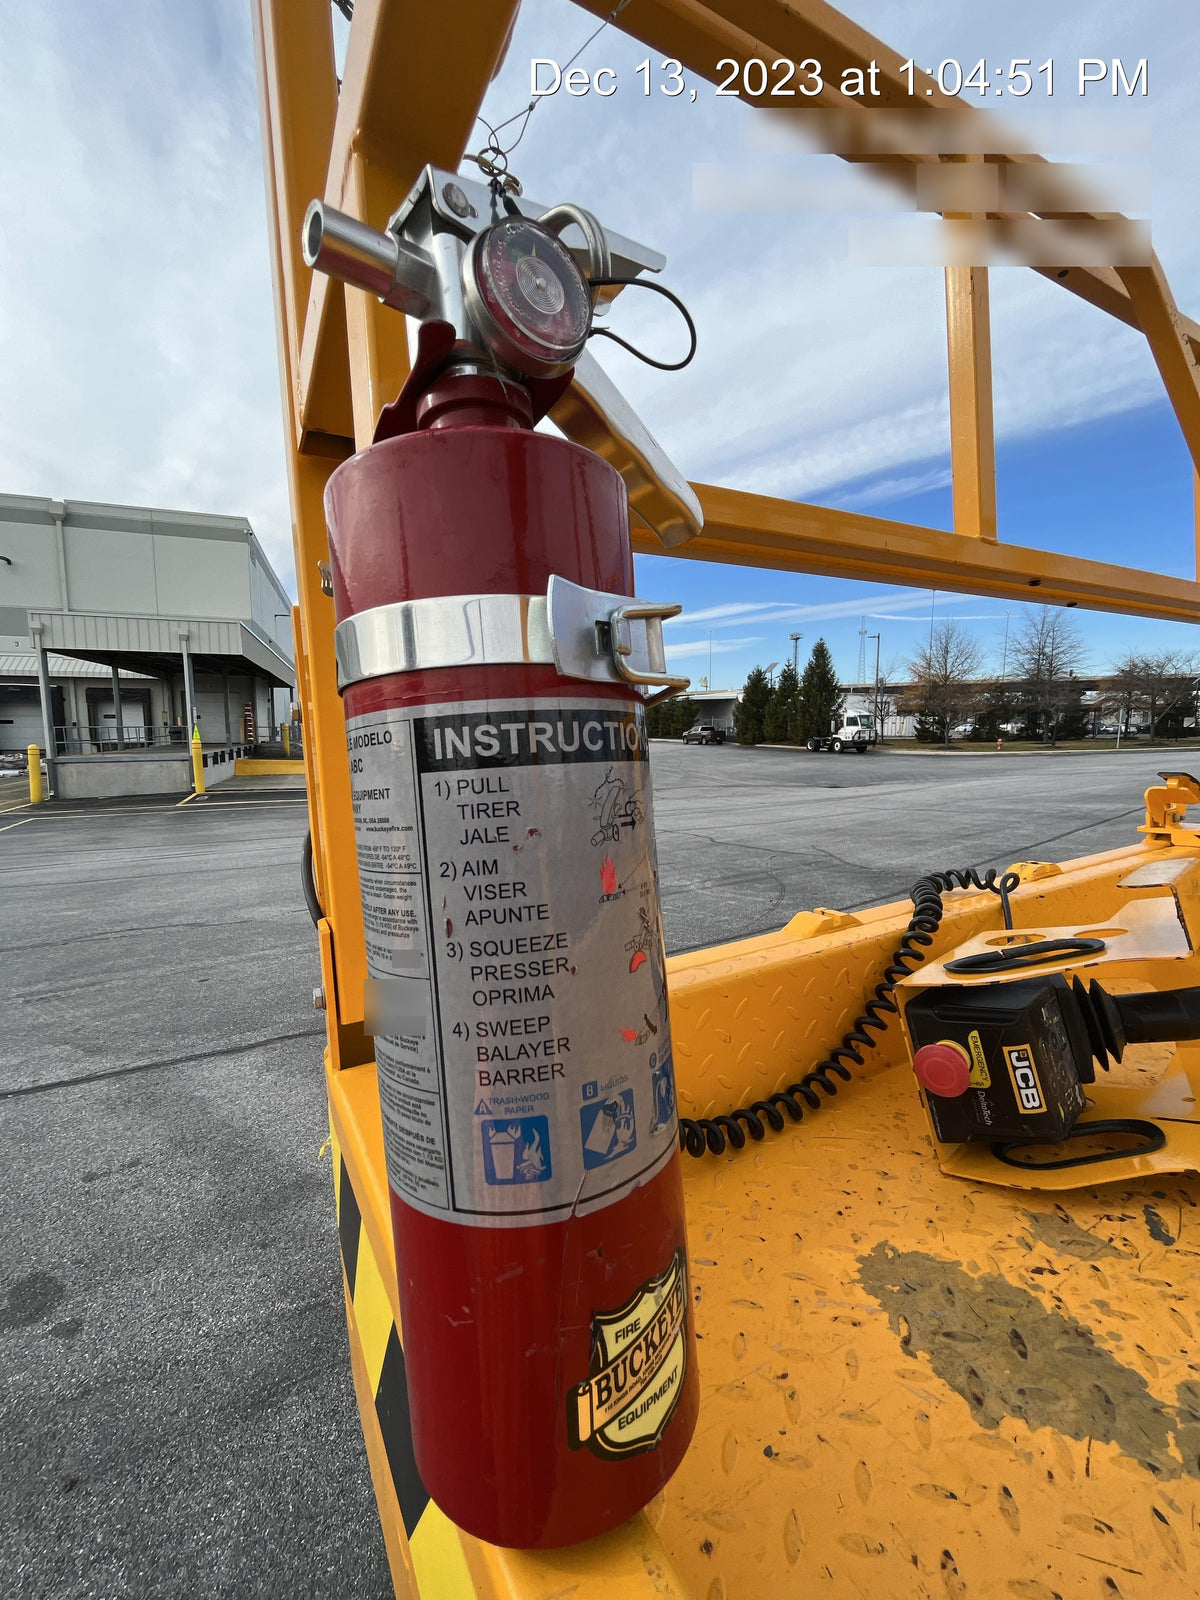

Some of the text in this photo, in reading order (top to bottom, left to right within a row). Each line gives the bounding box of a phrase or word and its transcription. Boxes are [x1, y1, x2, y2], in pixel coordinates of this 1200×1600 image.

[353, 730, 393, 749] MODELO
[434, 776, 510, 800] 1) PULL
[457, 801, 521, 820] TIRER
[460, 826, 510, 845] JALE
[440, 859, 499, 881] 2) AIM
[464, 882, 527, 901] VISER
[388, 908, 400, 917] ANY
[400, 910, 417, 918] USE.
[466, 904, 550, 926] APUNTE
[447, 932, 568, 960] 3) SQUEEZE
[471, 957, 570, 982] PRESSER
[473, 984, 555, 1007] OPRIMA
[452, 1016, 551, 1041] 4) SWEEP
[477, 1036, 571, 1062] BALAYER
[971, 1035, 988, 1082] EMERGENCY
[479, 1063, 566, 1087] BARRER
[1010, 1051, 1040, 1109] JCB
[504, 1105, 535, 1115] PAPER
[614, 1317, 641, 1344] FIRE
[618, 1366, 678, 1430] EQUIPMENT
